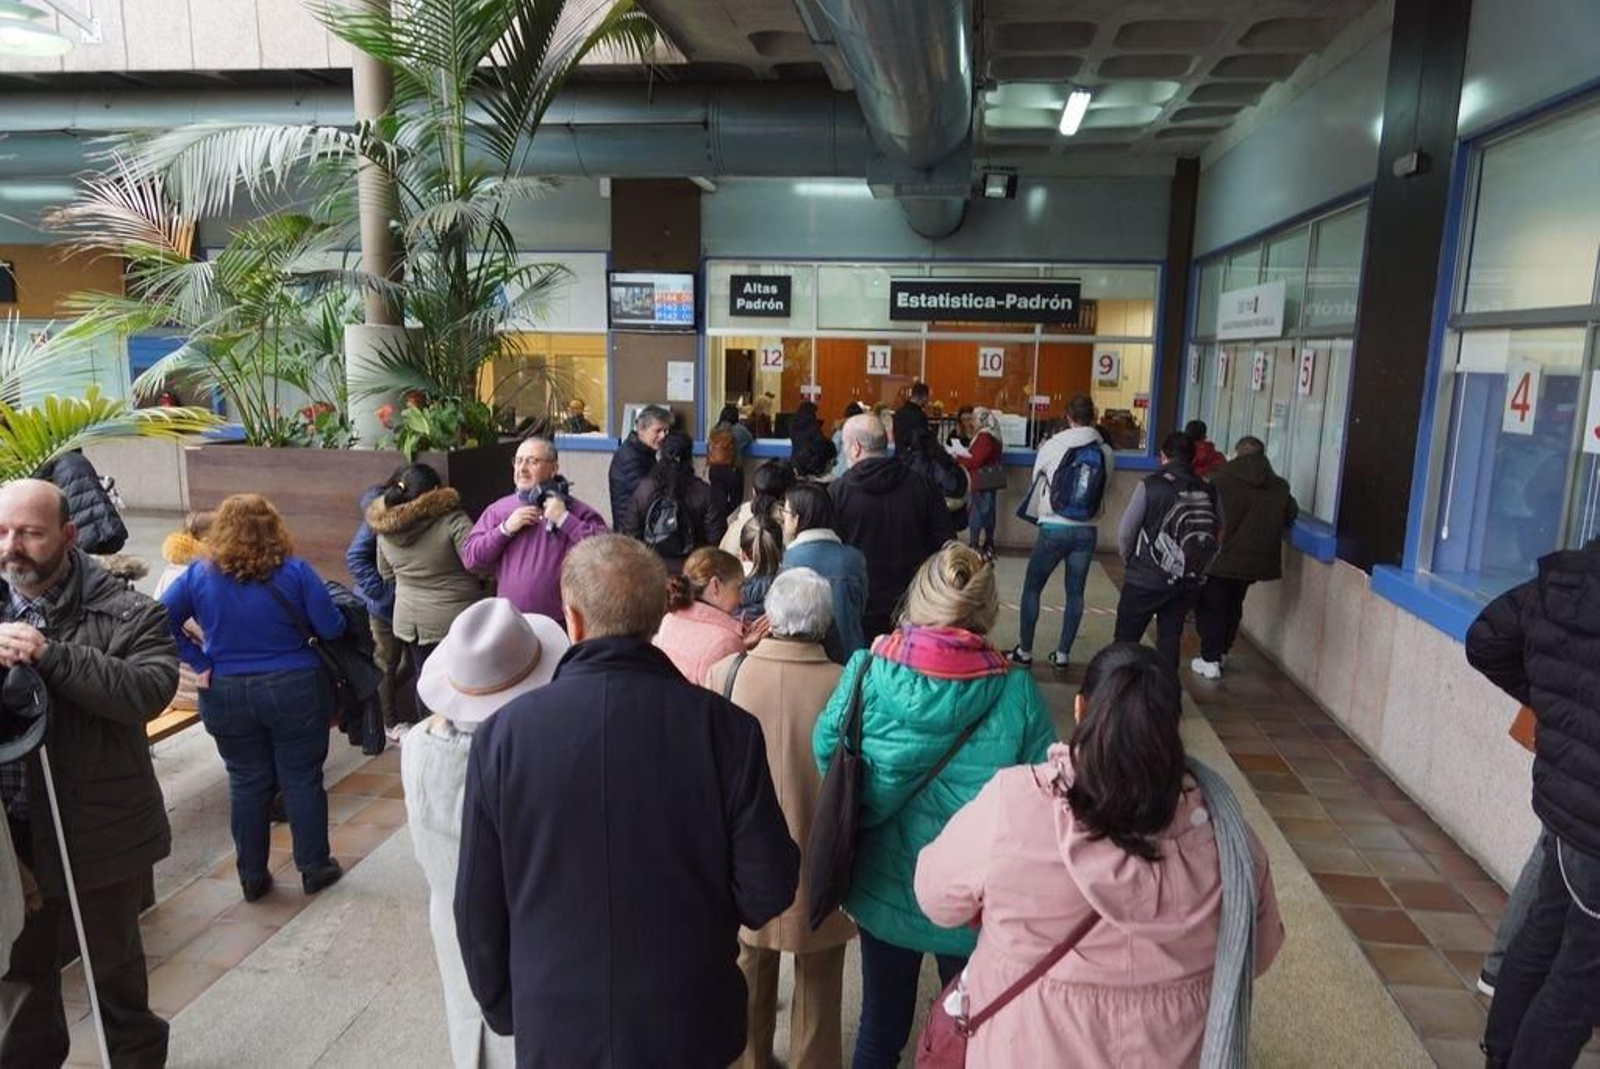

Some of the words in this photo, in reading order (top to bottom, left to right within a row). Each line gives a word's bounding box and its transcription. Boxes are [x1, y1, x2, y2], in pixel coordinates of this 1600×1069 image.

[743, 282, 779, 295] Altas
[736, 296, 784, 311] Padrón
[896, 291, 1073, 311] Estatística-Padrón
[761, 349, 782, 366] 12
[868, 351, 889, 369] 11
[980, 352, 1003, 372] 10
[1098, 355, 1114, 375] 9
[1253, 356, 1262, 384] 6
[1300, 356, 1311, 388] 5
[1510, 372, 1531, 422] 4
